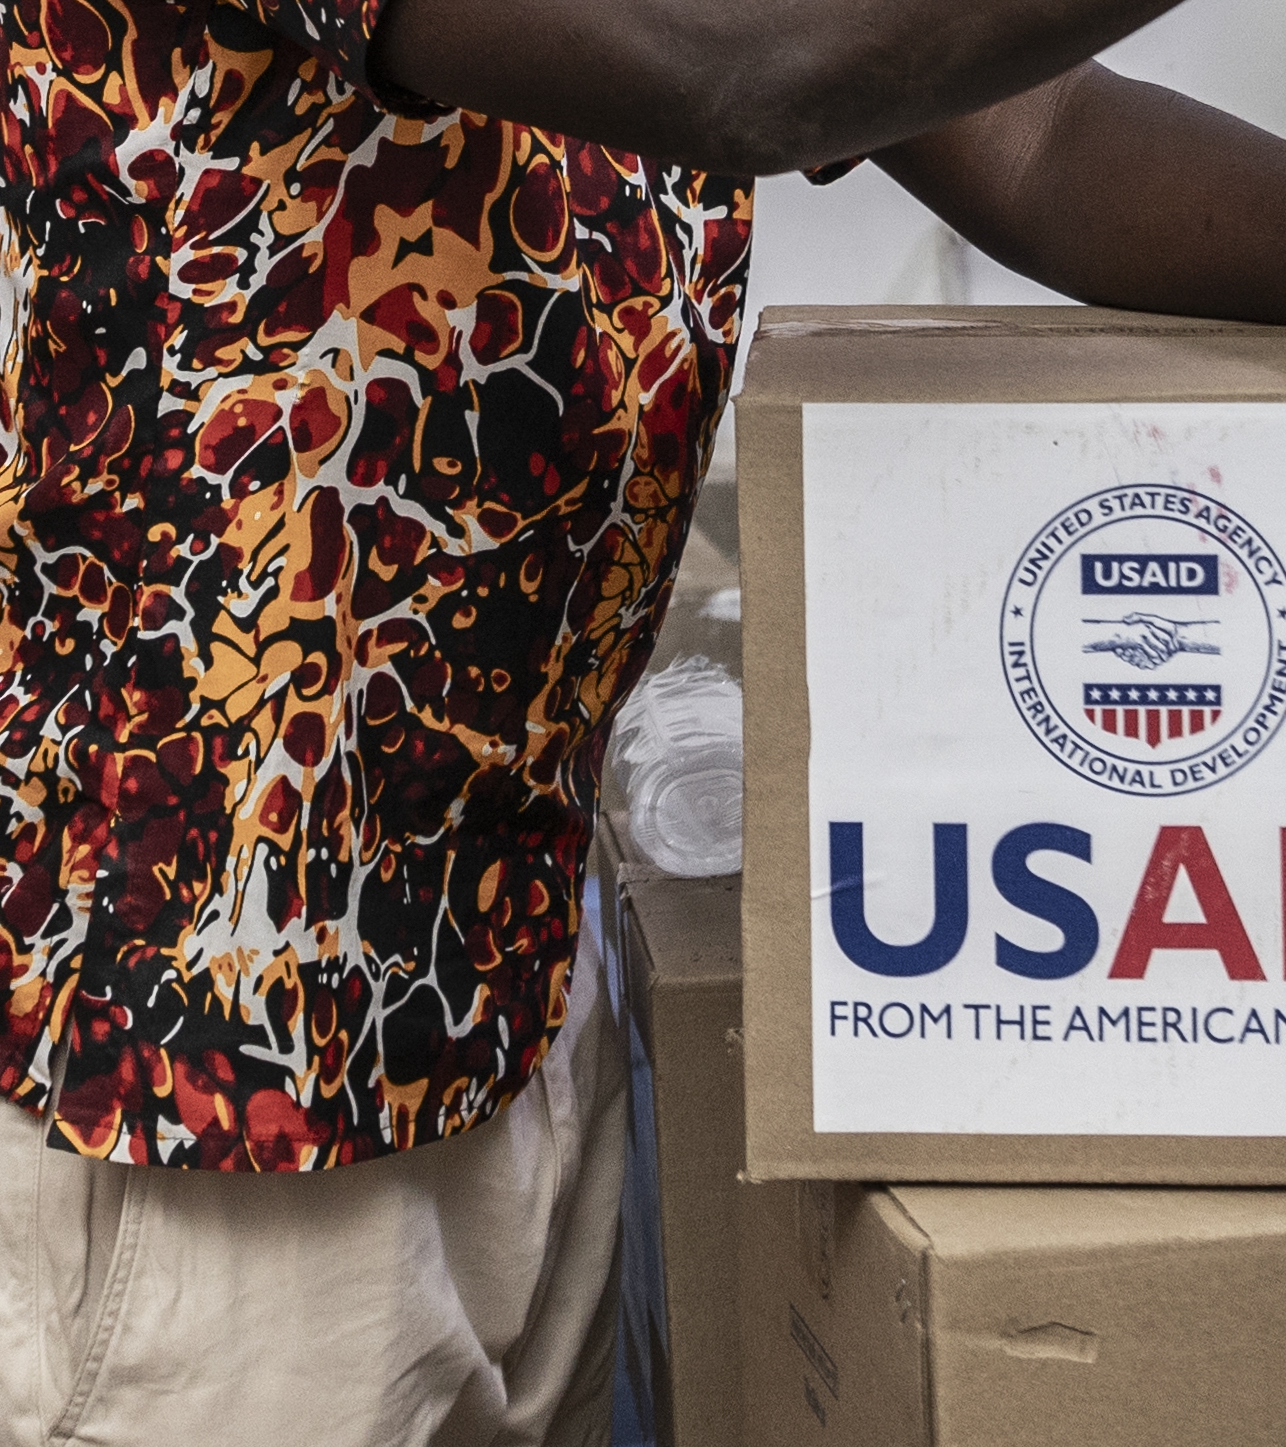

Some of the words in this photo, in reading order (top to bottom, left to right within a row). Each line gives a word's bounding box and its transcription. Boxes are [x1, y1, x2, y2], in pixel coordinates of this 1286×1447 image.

[1018, 508, 1093, 589] UNITED
[1099, 491, 1193, 517] STATES
[1195, 505, 1284, 589] AGENCY
[1094, 561, 1206, 588] USAID
[1008, 641, 1162, 788] INTERNATIONAL
[830, 1001, 952, 1039] FROM
[963, 1004, 1051, 1041] THE
